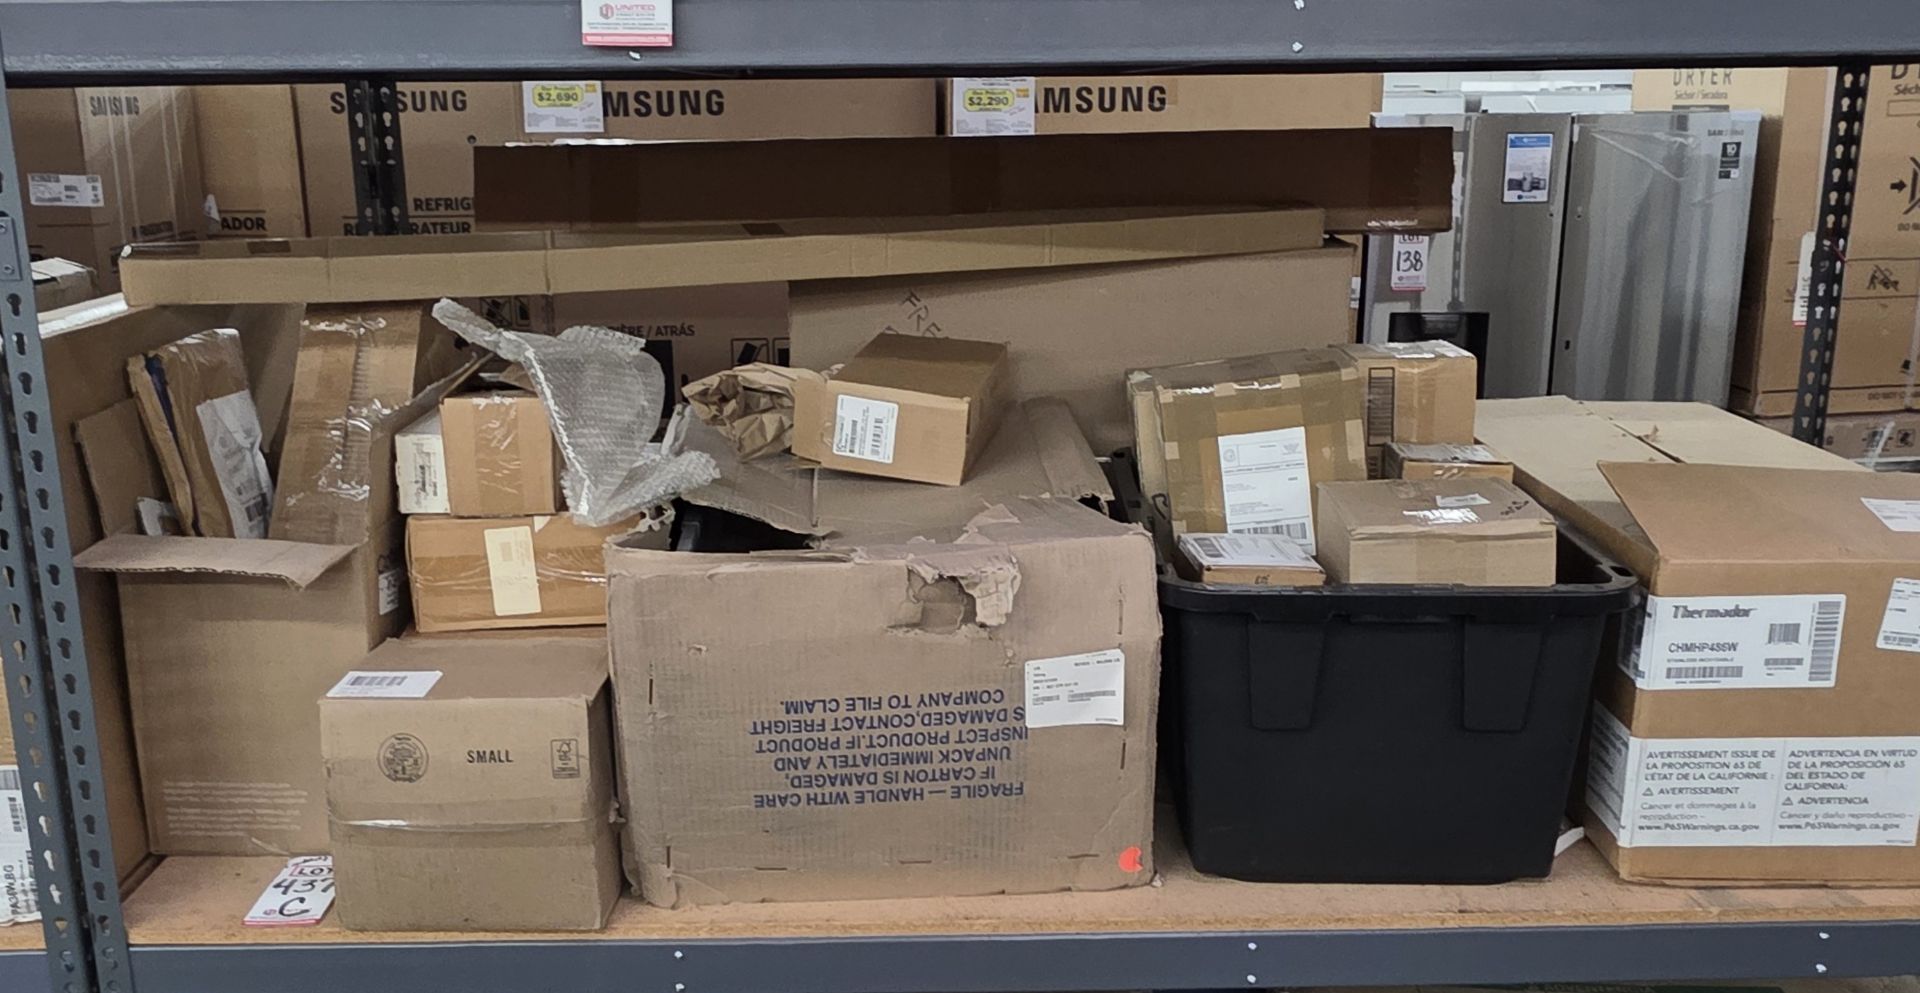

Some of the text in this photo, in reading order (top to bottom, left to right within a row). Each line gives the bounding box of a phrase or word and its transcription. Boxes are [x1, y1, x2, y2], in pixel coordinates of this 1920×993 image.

[329, 89, 468, 114] SSUNG
[603, 89, 725, 117] MSUNG
[1034, 86, 1167, 113] MSUNG
[413, 197, 474, 212] REFRIG
[220, 217, 267, 231] ADOR
[1396, 250, 1424, 273] 138
[655, 321, 696, 337] ATRÁS
[1672, 604, 1757, 619] Thermador
[780, 689, 1005, 715] COMPANY TO FILE CLAIM.
[1012, 706, 1025, 721] S
[749, 718, 826, 735] FREIGHT
[954, 726, 1028, 743] INSPECT
[755, 736, 840, 754] PRODUCT
[466, 750, 514, 763] SMALL
[774, 746, 1011, 772] UNPACK IMMEDIATELY AND
[1646, 750, 1776, 759] AVERTISSEMENT ISSUE DE
[1788, 749, 1918, 758] ADVERTENCIA EN VIRTUD
[1646, 762, 1659, 770] LA
[1661, 761, 1730, 770] PROPOSITION
[1748, 761, 1762, 769] DE
[1787, 761, 1802, 769] DE
[1804, 761, 1818, 769] LA
[785, 766, 995, 789] IF CARTON IS DAMAGED,
[1692, 772, 1706, 780] LA
[1707, 772, 1768, 780] CALIFORNIE
[1785, 771, 1866, 780] DEL ESTADO DE
[855, 787, 924, 804] HANDLE
[951, 782, 1024, 799] FRAGILE
[1657, 786, 1740, 795] AVERTISSEMENT
[754, 793, 802, 808] CARE
[806, 791, 850, 806] WITH
[1640, 802, 1672, 810] Cancer
[1686, 801, 1737, 811] dommages
[1748, 801, 1757, 809] la
[1797, 796, 1870, 805] ADVERTENCIA
[1640, 813, 1699, 821] reproduction
[1638, 822, 1760, 832] www.P65Warnings.ca.gov
[1778, 821, 1900, 832] www.P65Warnings.ca.gov
[272, 877, 336, 896] 437
[278, 896, 312, 917] C
